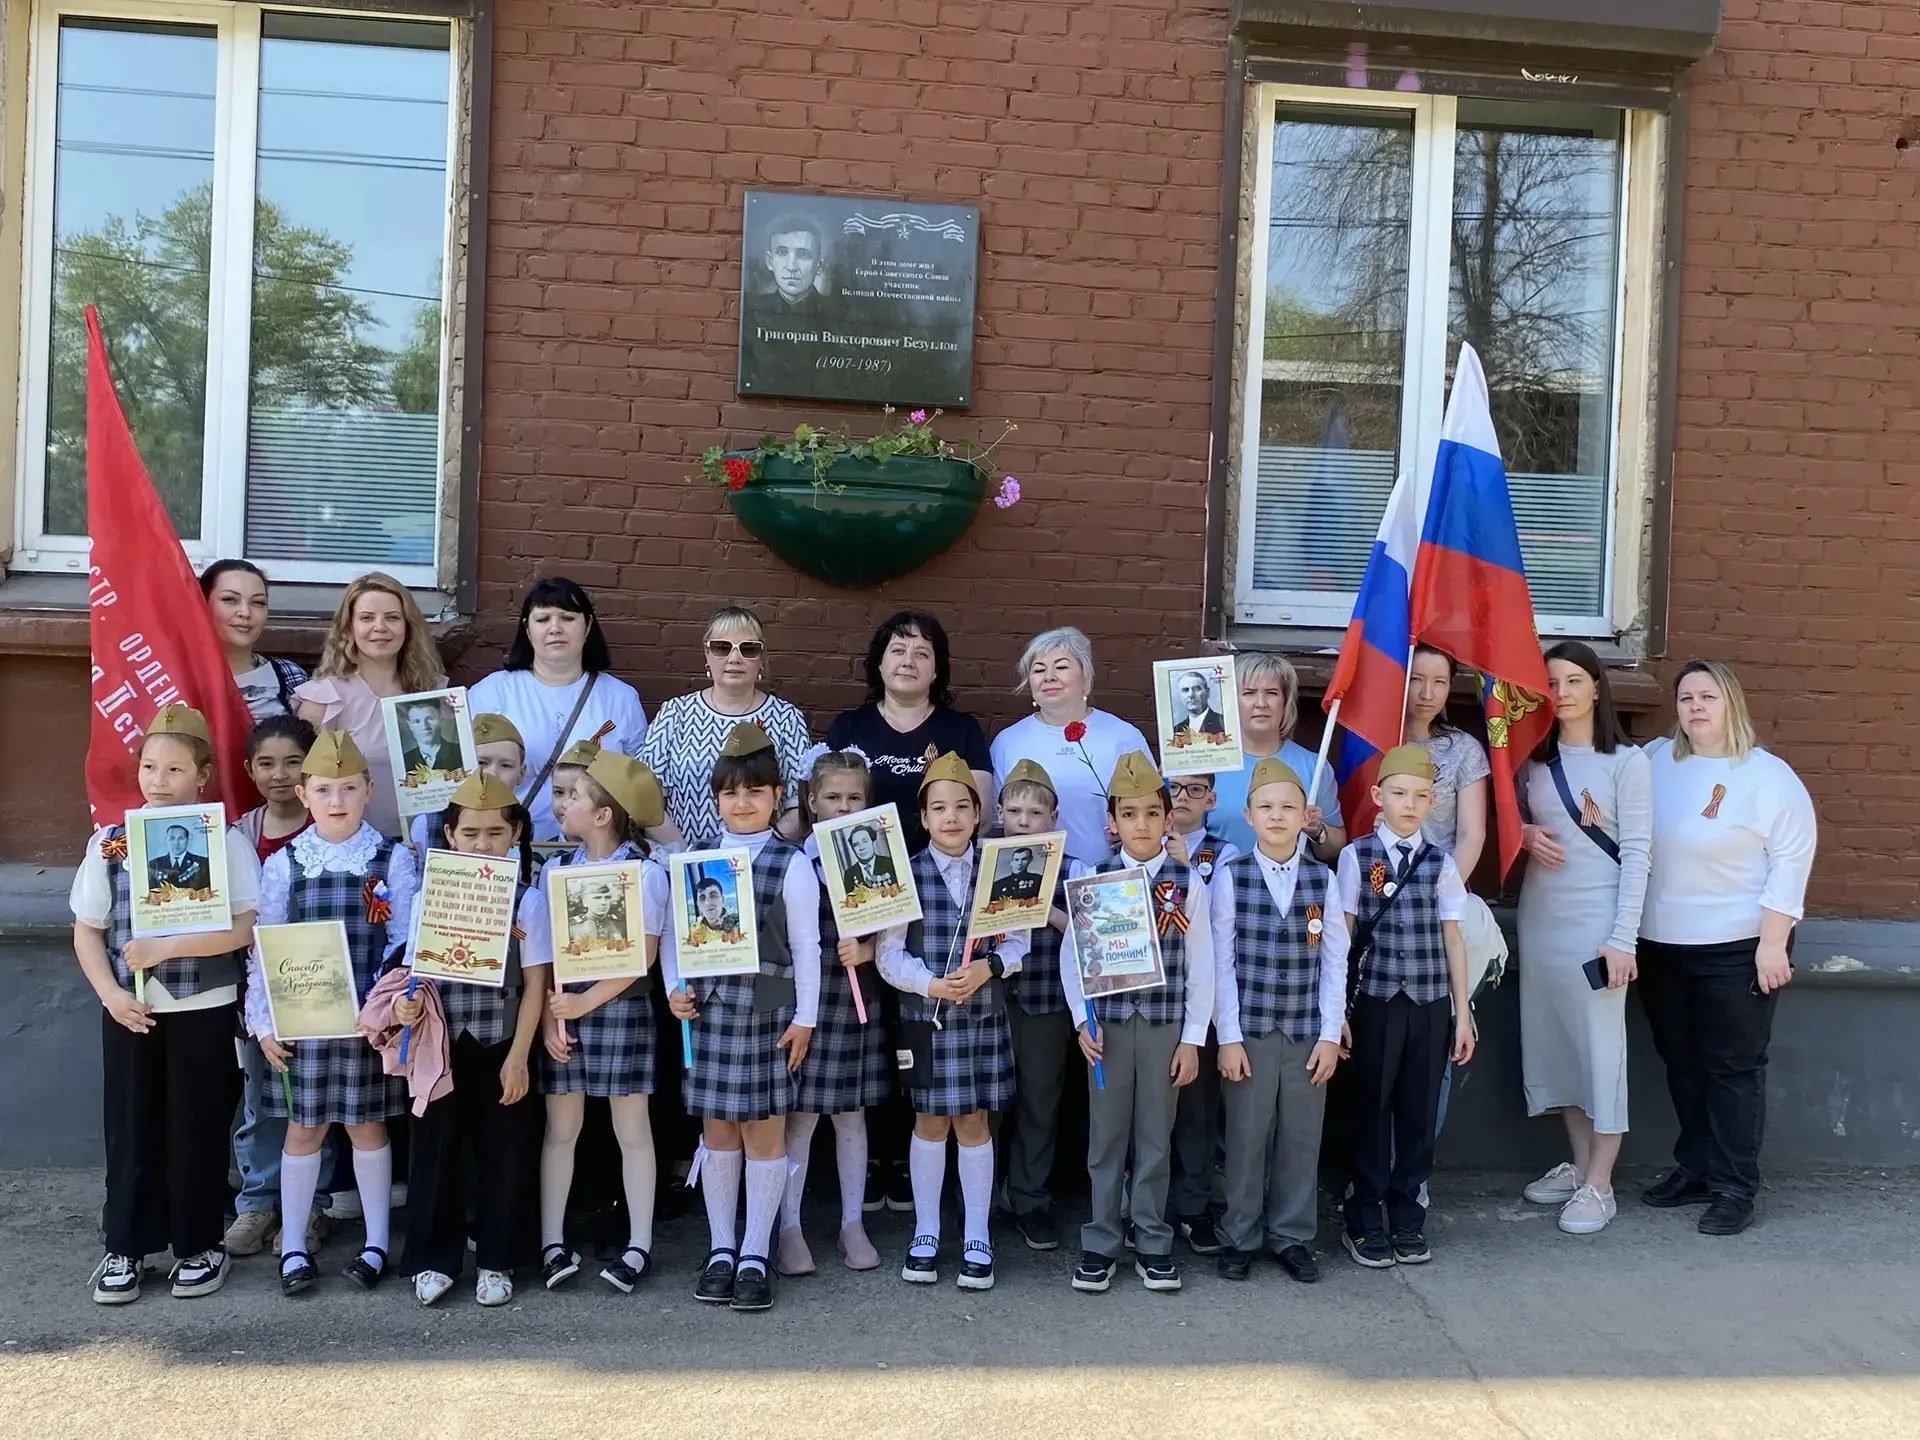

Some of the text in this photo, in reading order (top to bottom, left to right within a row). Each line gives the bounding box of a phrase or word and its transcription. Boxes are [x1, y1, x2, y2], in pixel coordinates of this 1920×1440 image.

[855, 268, 950, 281] Герой Советского Союза
[883, 281, 920, 290] участник
[841, 287, 962, 303] Великой Отечественной войны
[756, 326, 819, 344] Григорий
[822, 331, 900, 348] Викторович
[815, 355, 893, 375] (1907-1987)
[874, 754, 911, 765] Moon
[493, 874, 515, 883] ПОЛК
[1108, 938, 1129, 951] МЫ
[1105, 944, 1148, 962] ПОМНИМ!
